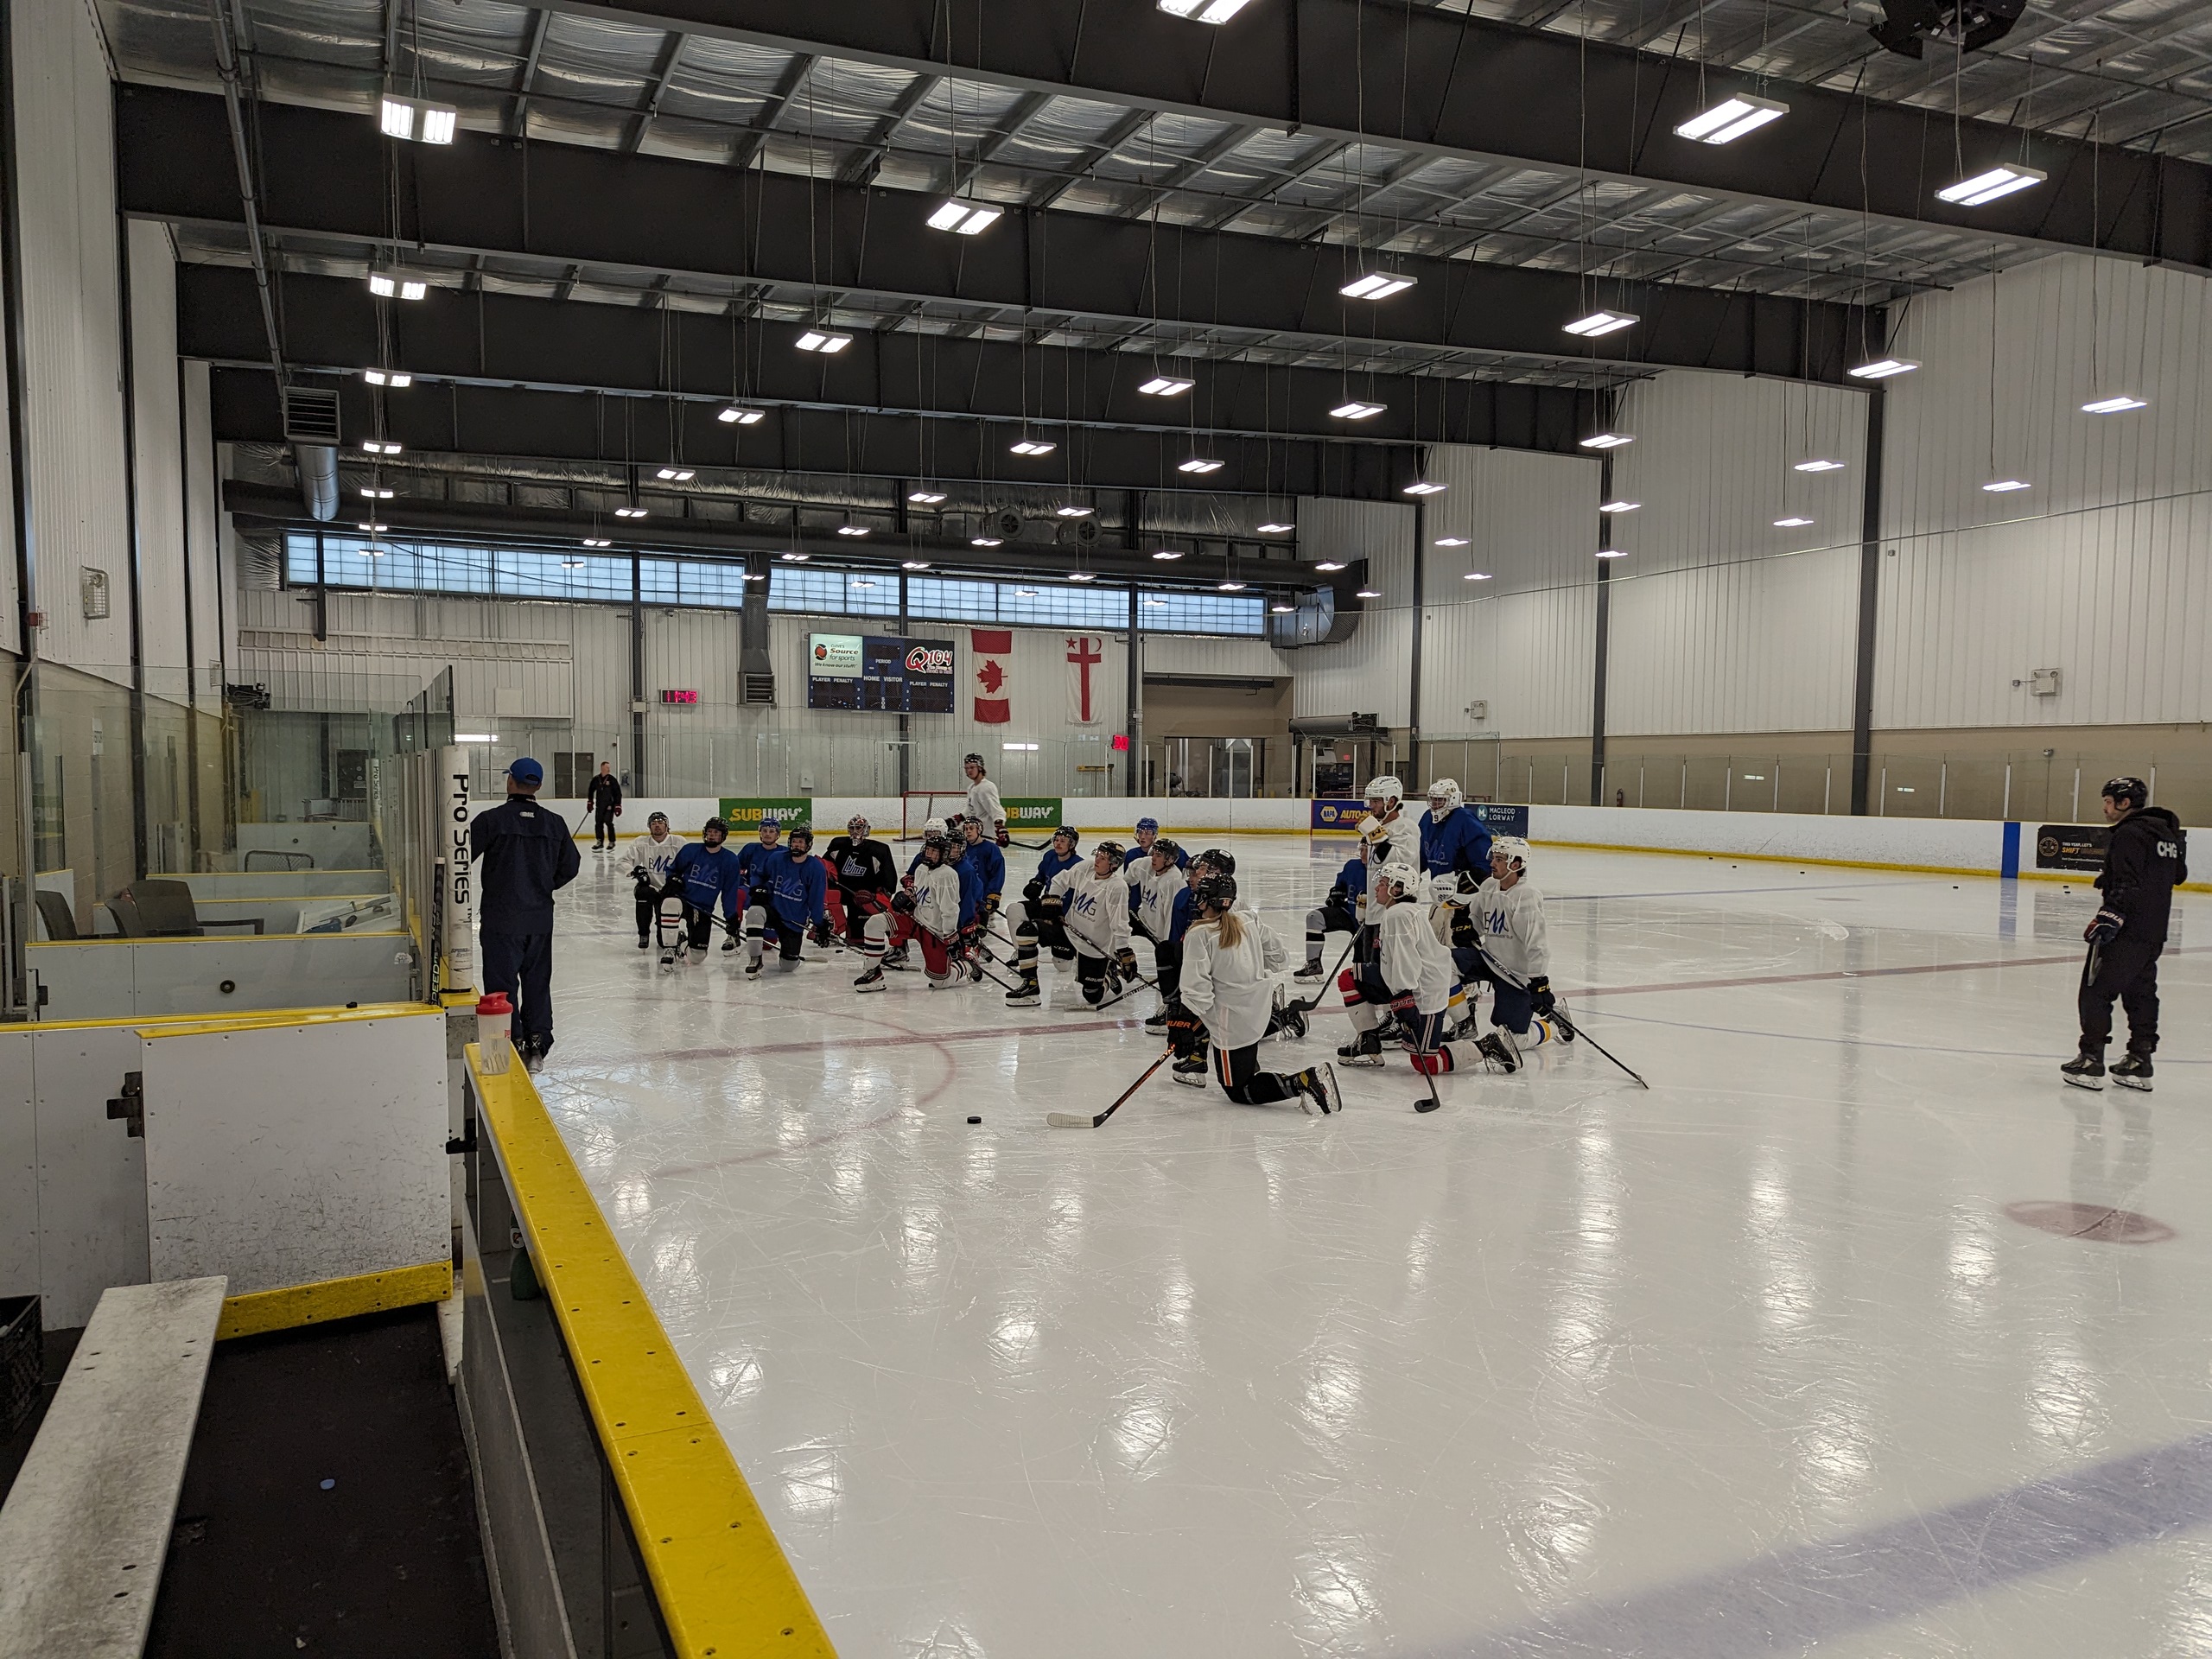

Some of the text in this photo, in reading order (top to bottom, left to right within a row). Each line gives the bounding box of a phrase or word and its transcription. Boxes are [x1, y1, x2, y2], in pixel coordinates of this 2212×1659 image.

[906, 646, 953, 674] Q104
[452, 773, 469, 823] Pro
[728, 806, 804, 823] SUBWAY
